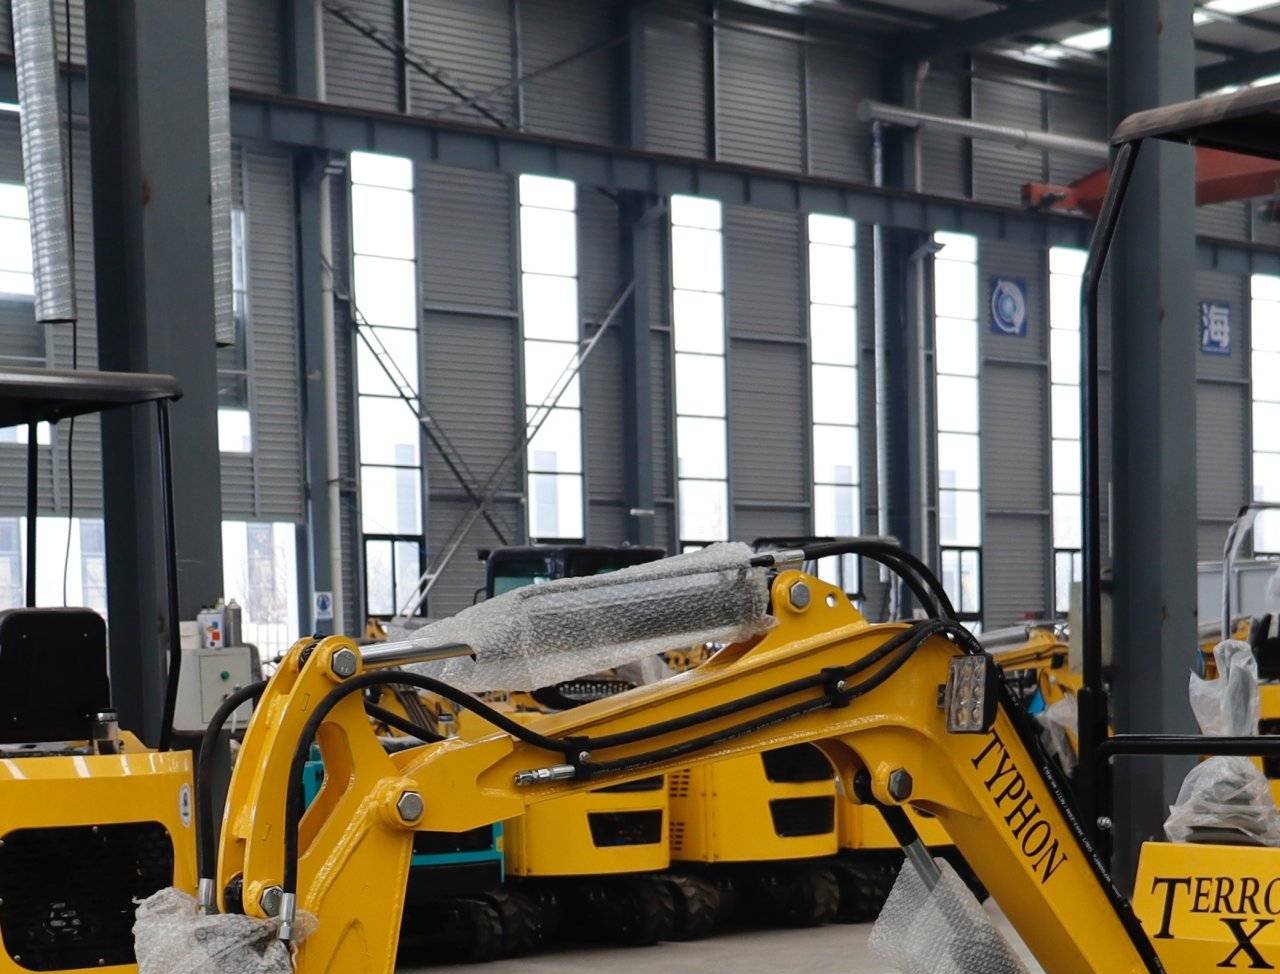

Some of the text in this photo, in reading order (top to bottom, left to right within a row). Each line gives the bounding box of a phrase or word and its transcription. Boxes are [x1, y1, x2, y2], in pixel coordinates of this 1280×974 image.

[1201, 302, 1230, 348] 海
[970, 727, 1069, 885] TYPHON
[1215, 917, 1276, 970] X
